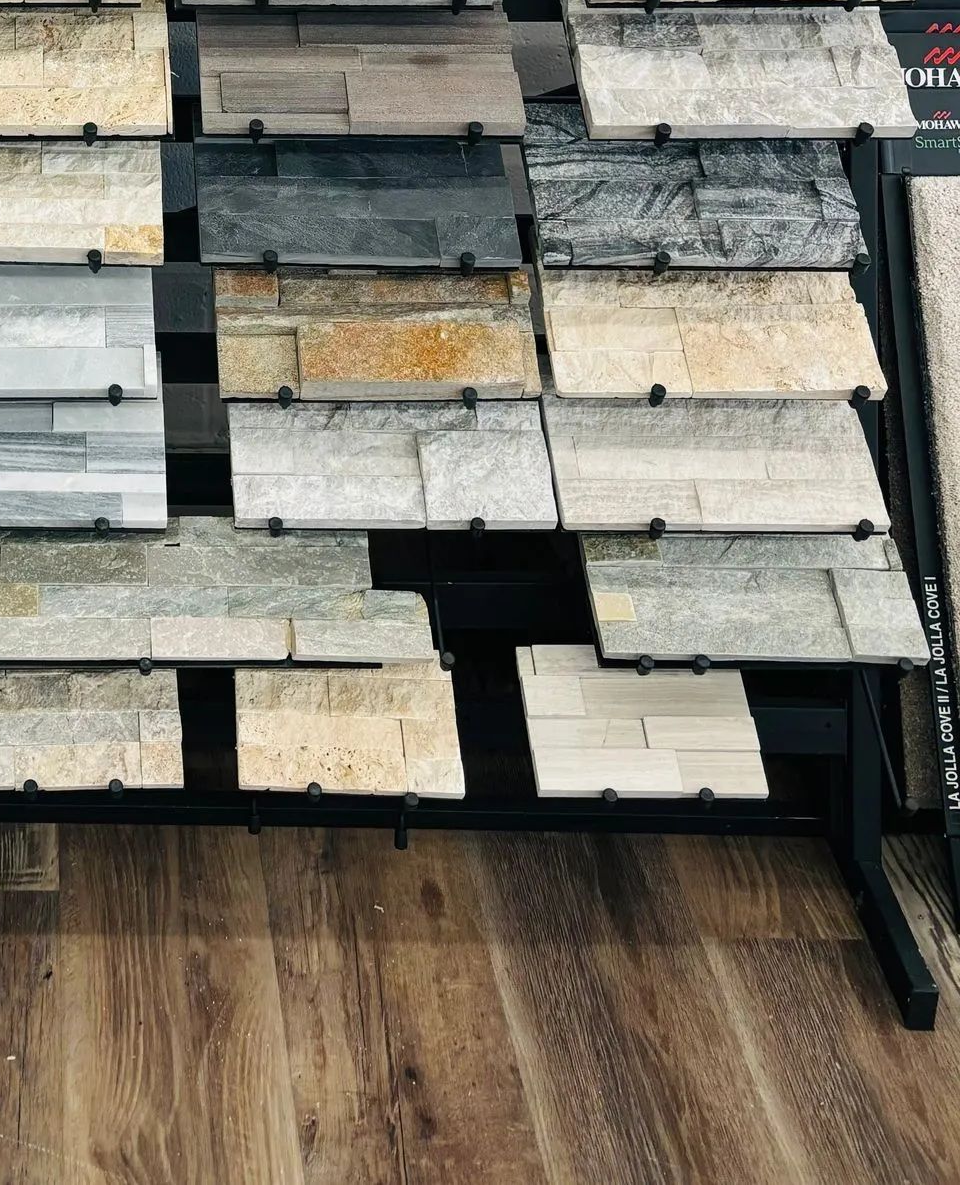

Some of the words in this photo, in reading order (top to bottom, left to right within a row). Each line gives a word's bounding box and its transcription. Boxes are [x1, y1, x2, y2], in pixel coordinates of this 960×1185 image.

[924, 583, 941, 619] COVE
[929, 622, 946, 665] JOLLA
[934, 667, 948, 685] LA
[937, 695, 949, 703] II
[939, 706, 954, 742] COVE
[943, 745, 959, 789] JOLLA
[948, 792, 960, 810] LA
